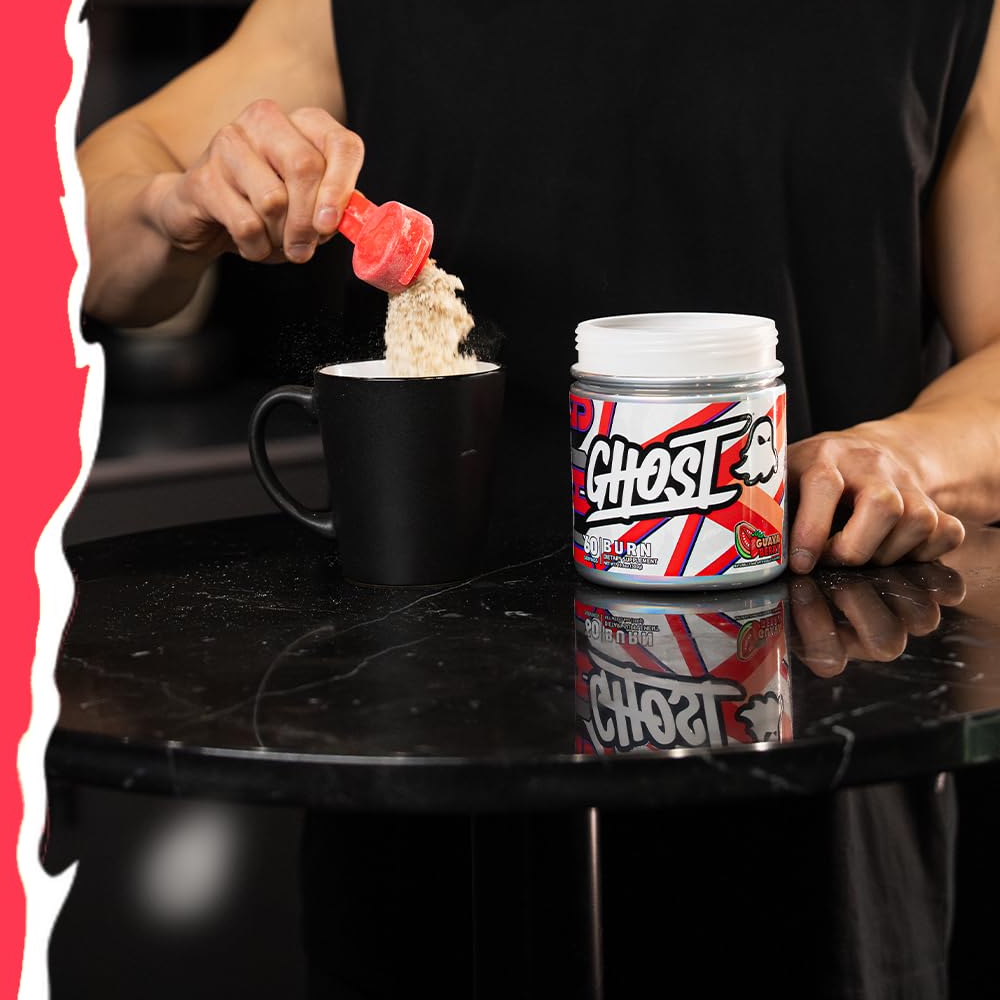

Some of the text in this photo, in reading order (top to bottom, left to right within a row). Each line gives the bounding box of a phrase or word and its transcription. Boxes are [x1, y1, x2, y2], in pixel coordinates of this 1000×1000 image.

[585, 414, 751, 522] GHOST
[583, 534, 651, 557] 60 BURN
